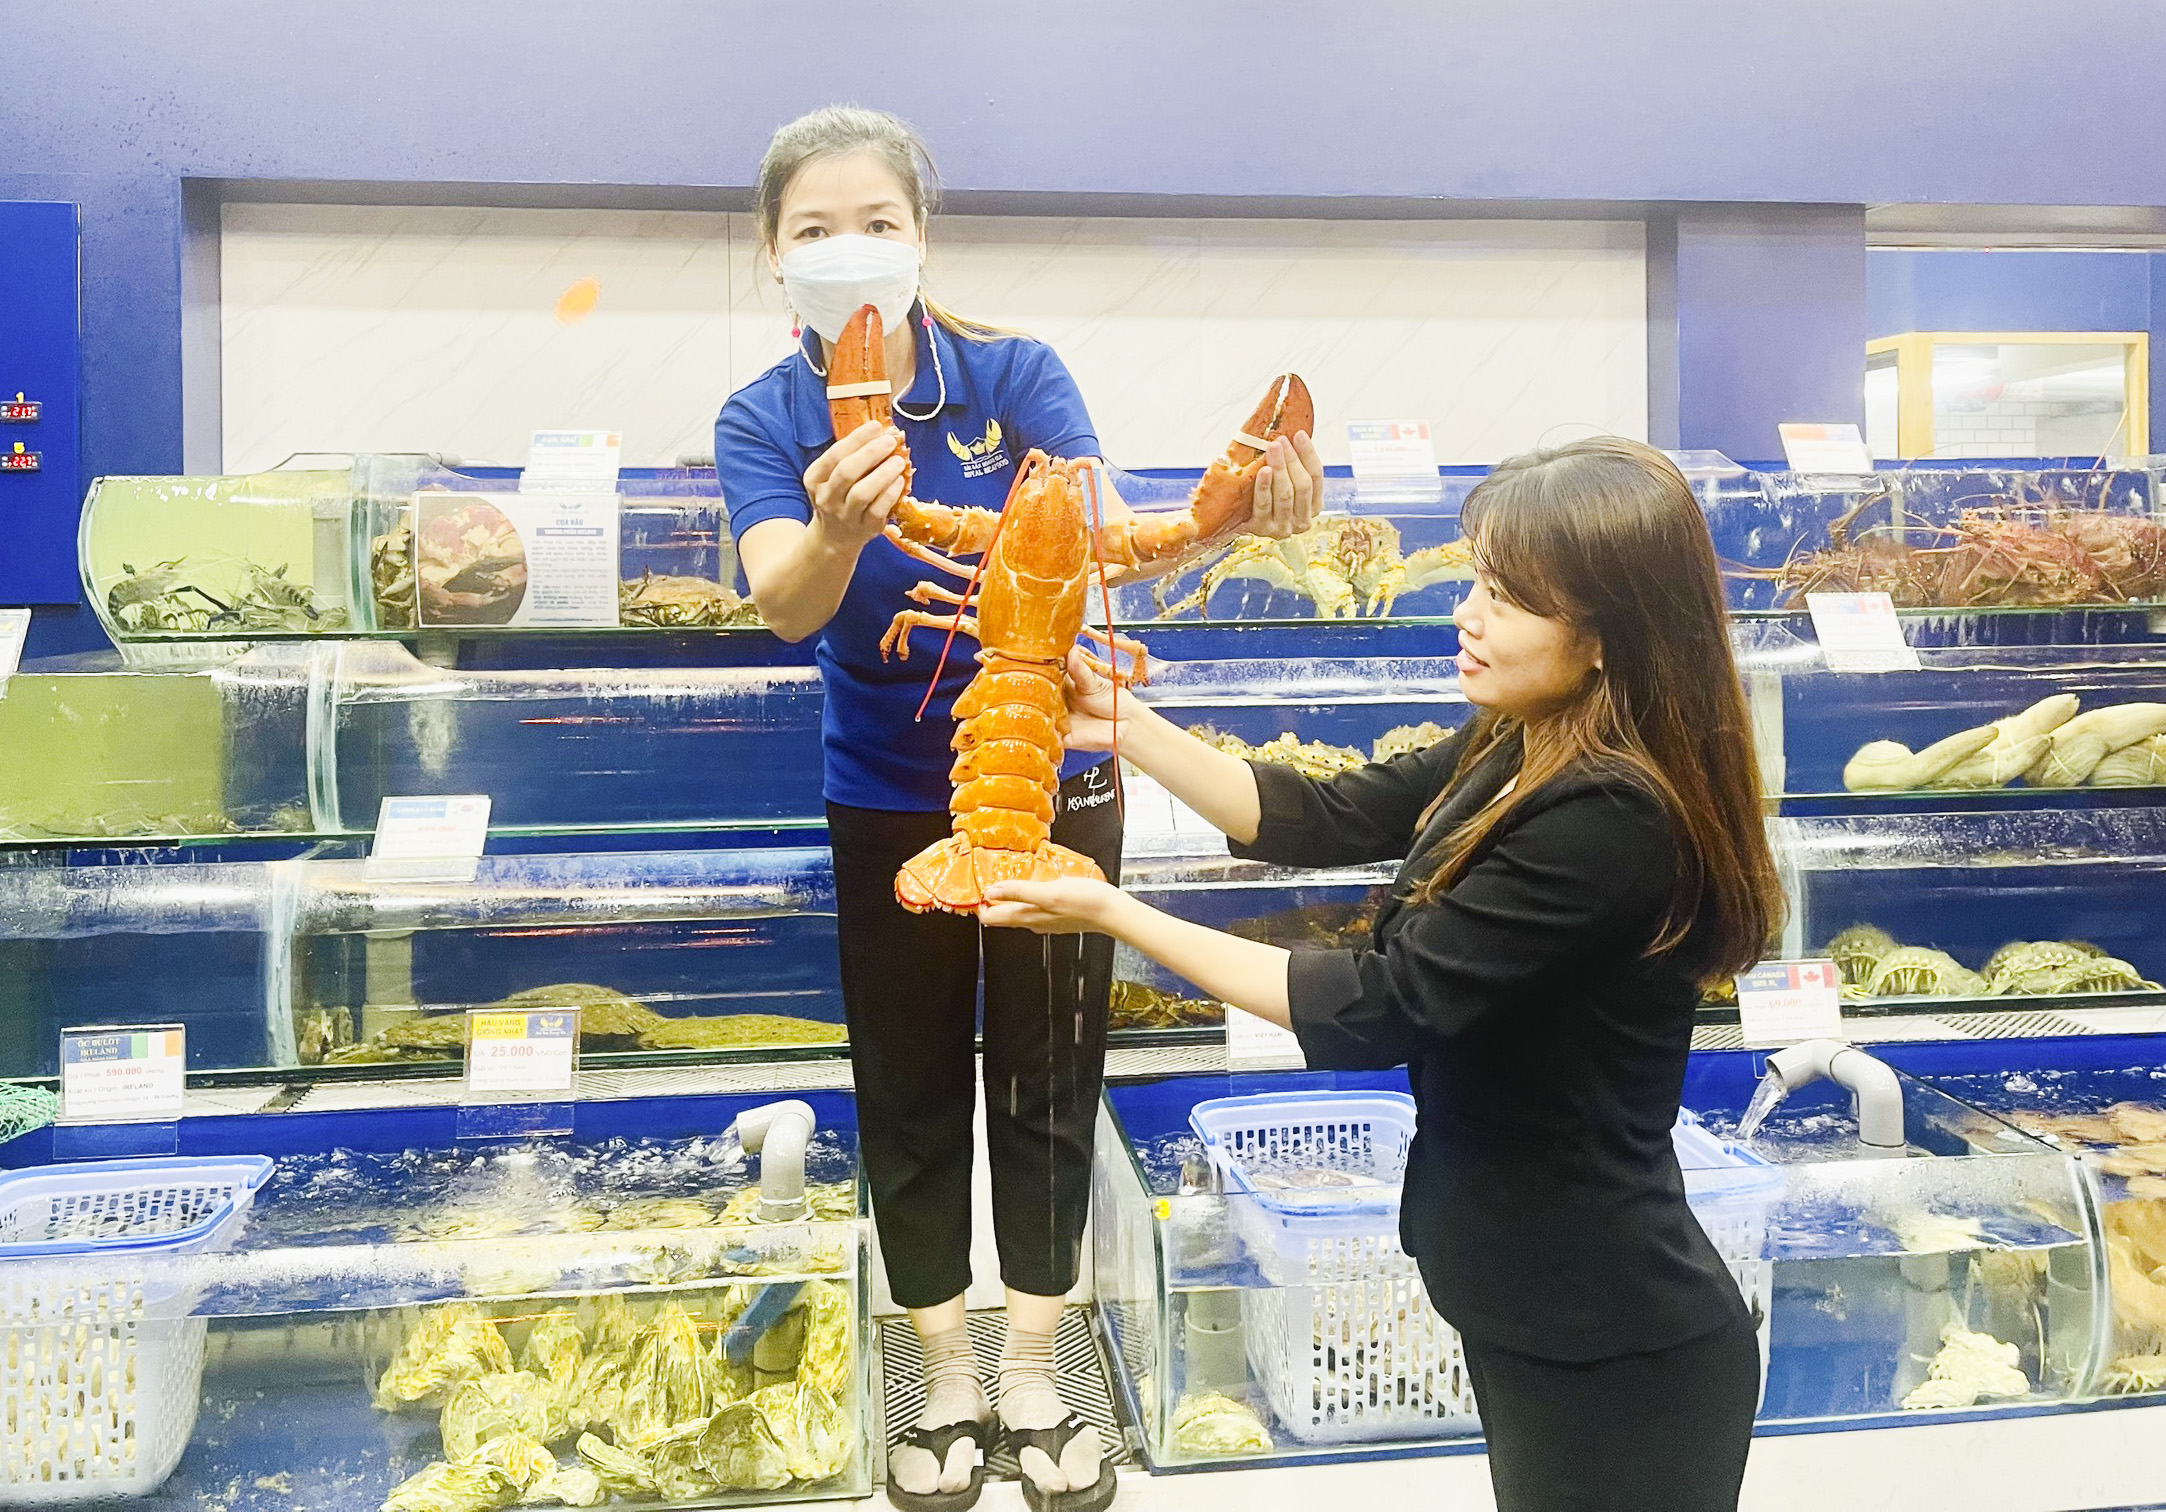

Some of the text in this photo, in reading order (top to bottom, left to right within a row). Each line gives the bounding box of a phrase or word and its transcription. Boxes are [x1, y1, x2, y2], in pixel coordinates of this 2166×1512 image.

[80, 1046, 118, 1057] IRELAND
[490, 1045, 533, 1057] 25.000
[106, 1066, 142, 1077] 590.000
[122, 1083, 154, 1091] IRELAND
[1153, 1198, 1172, 1220] 3
